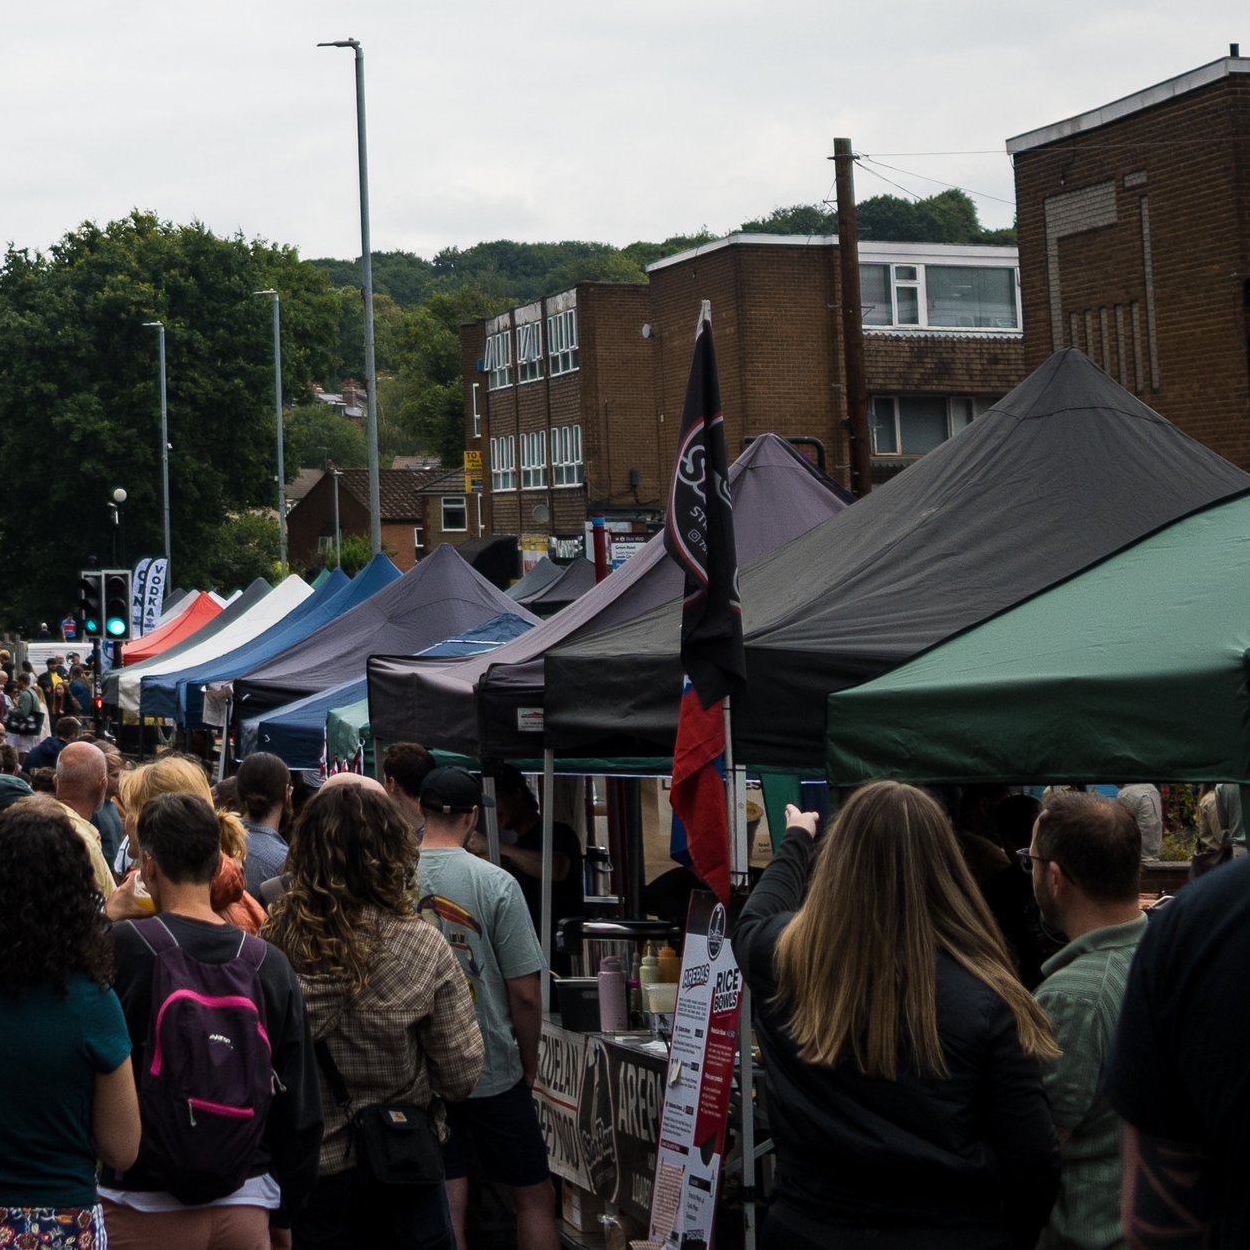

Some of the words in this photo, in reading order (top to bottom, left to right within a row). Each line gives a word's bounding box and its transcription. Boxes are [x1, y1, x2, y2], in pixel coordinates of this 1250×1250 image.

[146, 565, 164, 617] VODKA
[682, 963, 710, 989] AREPAS
[717, 968, 739, 993] RICE
[714, 991, 738, 1011] BOWLS
